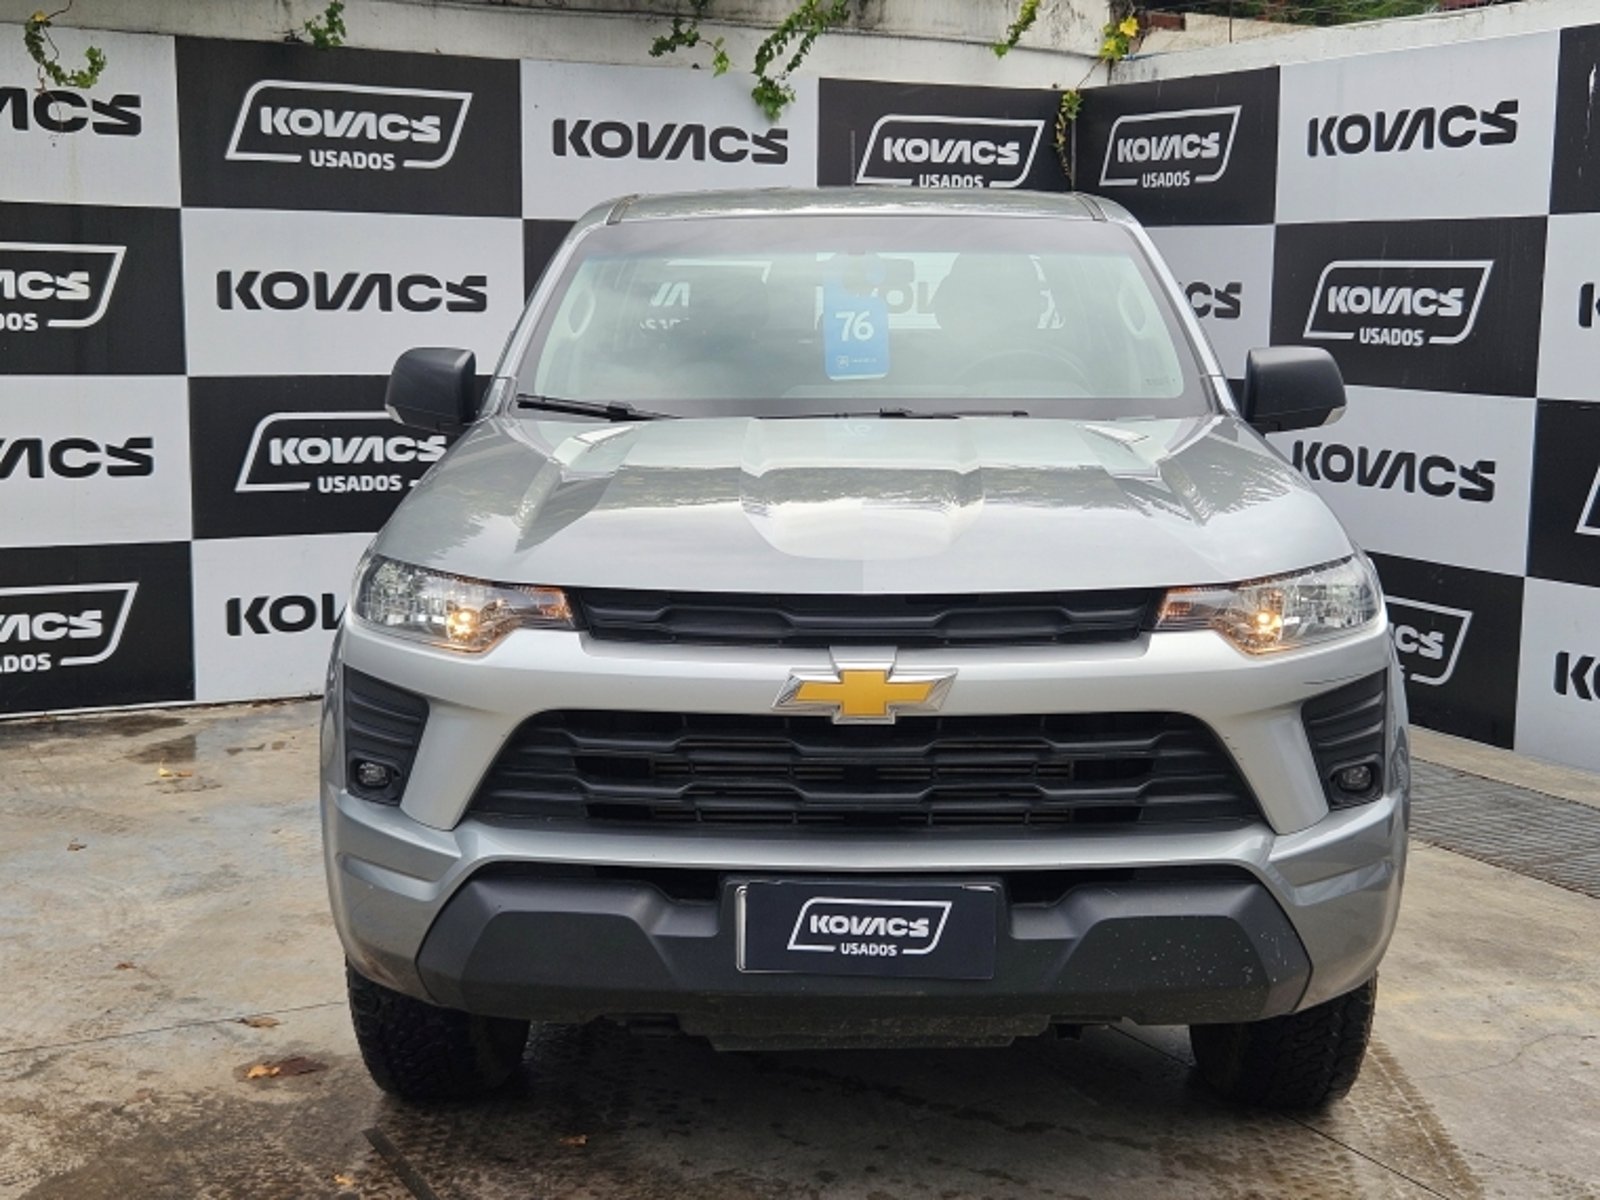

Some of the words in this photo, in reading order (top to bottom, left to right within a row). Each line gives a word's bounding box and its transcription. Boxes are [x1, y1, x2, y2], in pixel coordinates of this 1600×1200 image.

[0, 86, 142, 136] ACS
[261, 107, 440, 143] KOVACS
[553, 118, 788, 164] KOVACS
[1308, 100, 1518, 157] KOVACS
[309, 150, 395, 170] USADOS
[884, 137, 1019, 165] KOVACS
[1117, 131, 1220, 162] KOVACS
[919, 174, 984, 188] USADOS
[1142, 170, 1190, 187] USADOS
[217, 270, 487, 312] KOVACS
[1328, 287, 1464, 316] KOVACS
[835, 310, 874, 341] 76
[1360, 327, 1424, 346] USADOS
[0, 437, 153, 479] ACS
[270, 436, 447, 465] KOVACS
[318, 475, 402, 493] USADOS
[1292, 440, 1496, 502] KOVACS
[0, 610, 102, 642] ACS
[226, 593, 346, 636] KOV
[0, 653, 51, 673] DOS
[810, 914, 929, 937] KOVACS
[841, 942, 897, 956] USADOS
